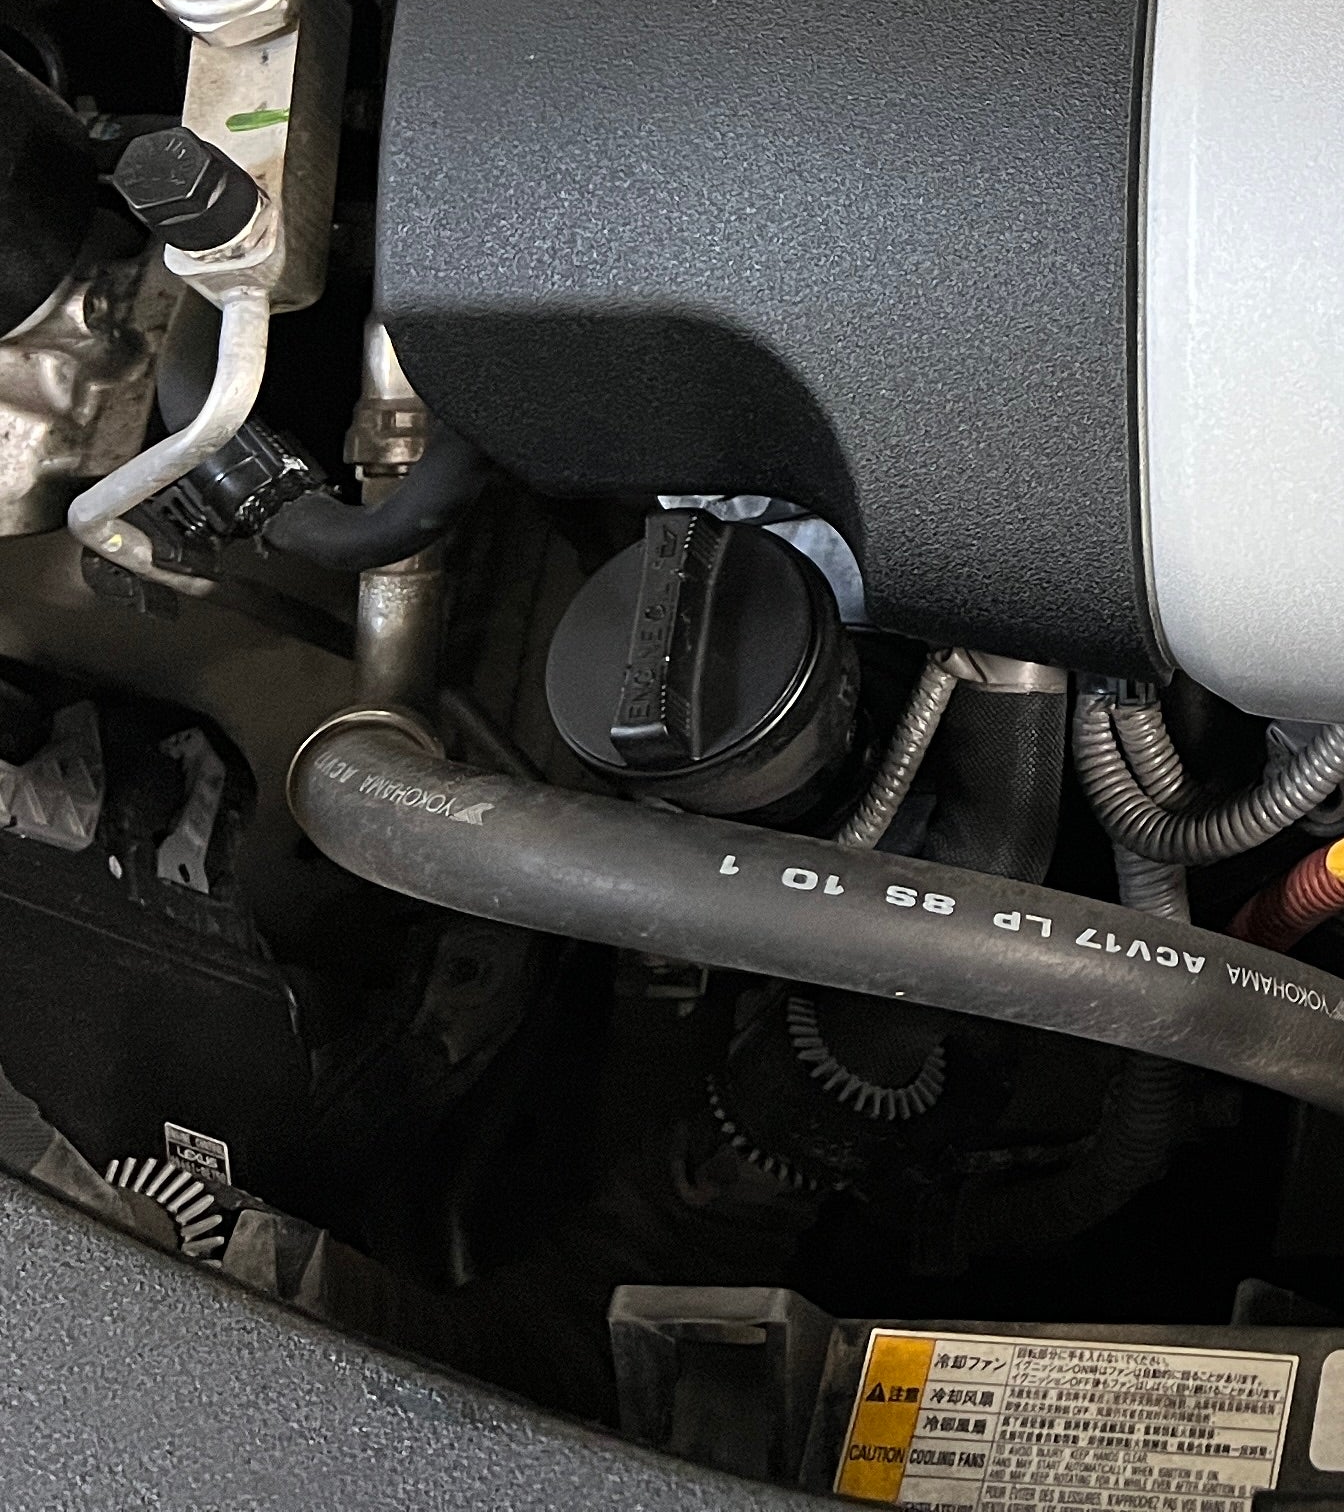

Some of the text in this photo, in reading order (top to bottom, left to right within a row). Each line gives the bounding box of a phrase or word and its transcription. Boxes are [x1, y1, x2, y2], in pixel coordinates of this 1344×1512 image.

[359, 774, 457, 817] YOKOHAMA
[719, 854, 1329, 1015] YOKOHAMA ACV17 LP 8S 10 1
[934, 1352, 1007, 1371] 冷却ファン
[849, 1444, 905, 1464] CAUTION
[909, 1447, 987, 1469] COOLING FANS
